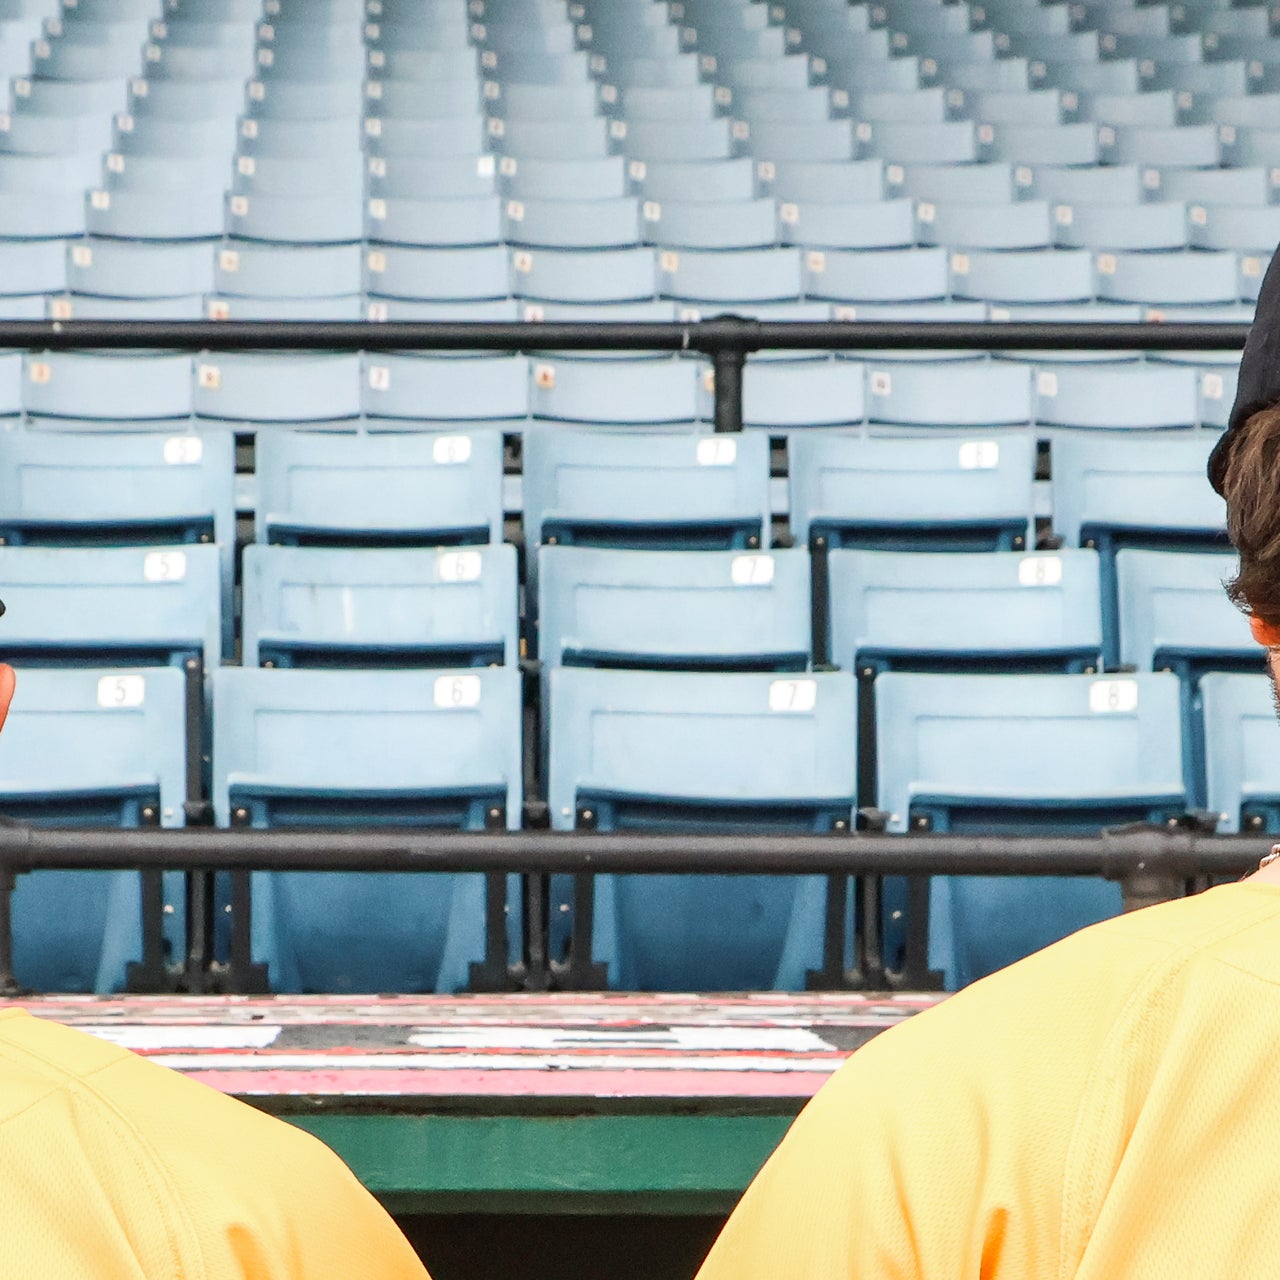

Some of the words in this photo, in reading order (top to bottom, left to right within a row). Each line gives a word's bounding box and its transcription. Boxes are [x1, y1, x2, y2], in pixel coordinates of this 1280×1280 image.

[113, 677, 126, 705] 5
[450, 677, 464, 704] 6
[788, 682, 799, 709] 7
[1107, 683, 1120, 710] 8
